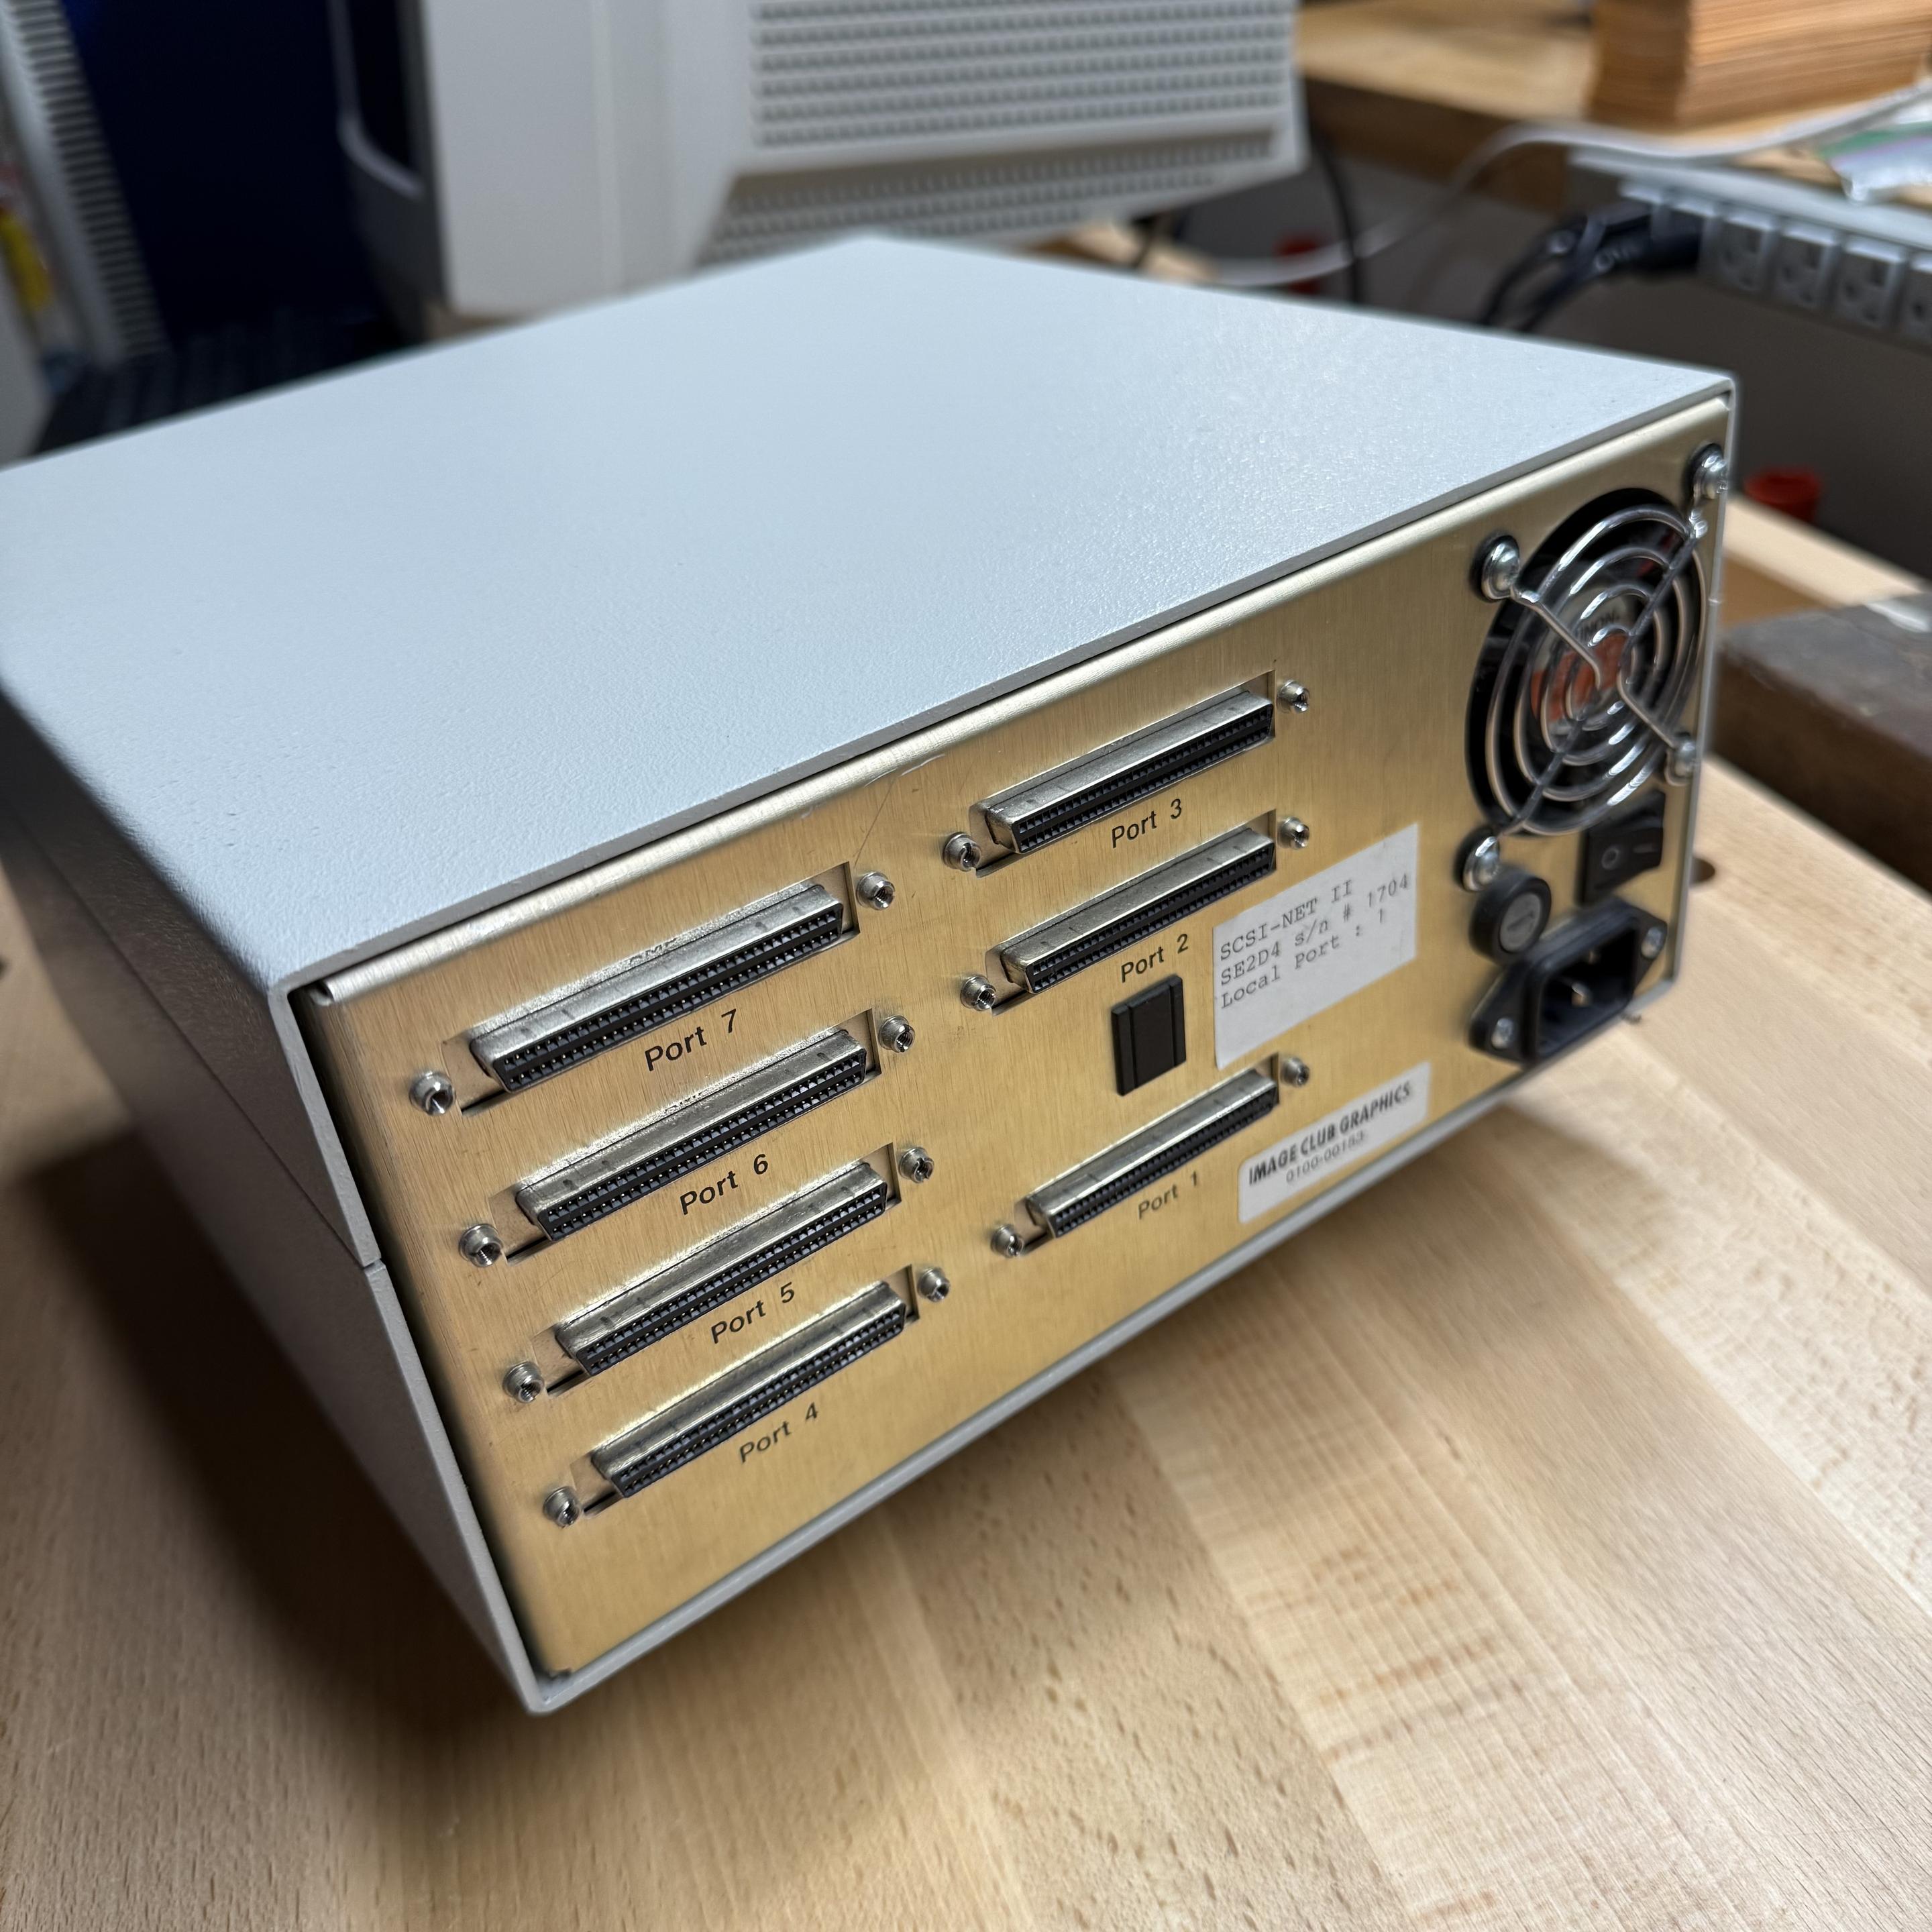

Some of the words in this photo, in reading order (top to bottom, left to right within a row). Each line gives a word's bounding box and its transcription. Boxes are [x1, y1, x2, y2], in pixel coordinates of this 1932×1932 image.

[1112, 810, 1157, 849] Port
[1170, 798, 1182, 820] 3
[1220, 898, 1318, 960] SCSI-NET
[1331, 880, 1352, 904] II
[1221, 942, 1281, 986] SE2D4
[1295, 920, 1328, 947] s/n
[1343, 905, 1351, 921] #
[1368, 873, 1408, 907] 1704
[1121, 946, 1164, 983] Port
[1177, 933, 1188, 954] 2
[1221, 966, 1281, 1009] Local
[1379, 908, 1383, 924] 1
[645, 1026, 707, 1072] Port
[721, 1008, 737, 1034] 7
[1248, 1143, 1297, 1185] IMAGE
[1300, 1122, 1335, 1157] CLUB
[1340, 1080, 1411, 1135] GRAPHICS
[680, 1171, 738, 1216] Port
[753, 1153, 769, 1175] 6
[1138, 1184, 1178, 1220] Port
[1191, 1171, 1197, 1187] 1
[711, 1300, 766, 1344] Port
[780, 1281, 795, 1303] 5
[739, 1420, 792, 1464] Port
[806, 1401, 818, 1421] 4
